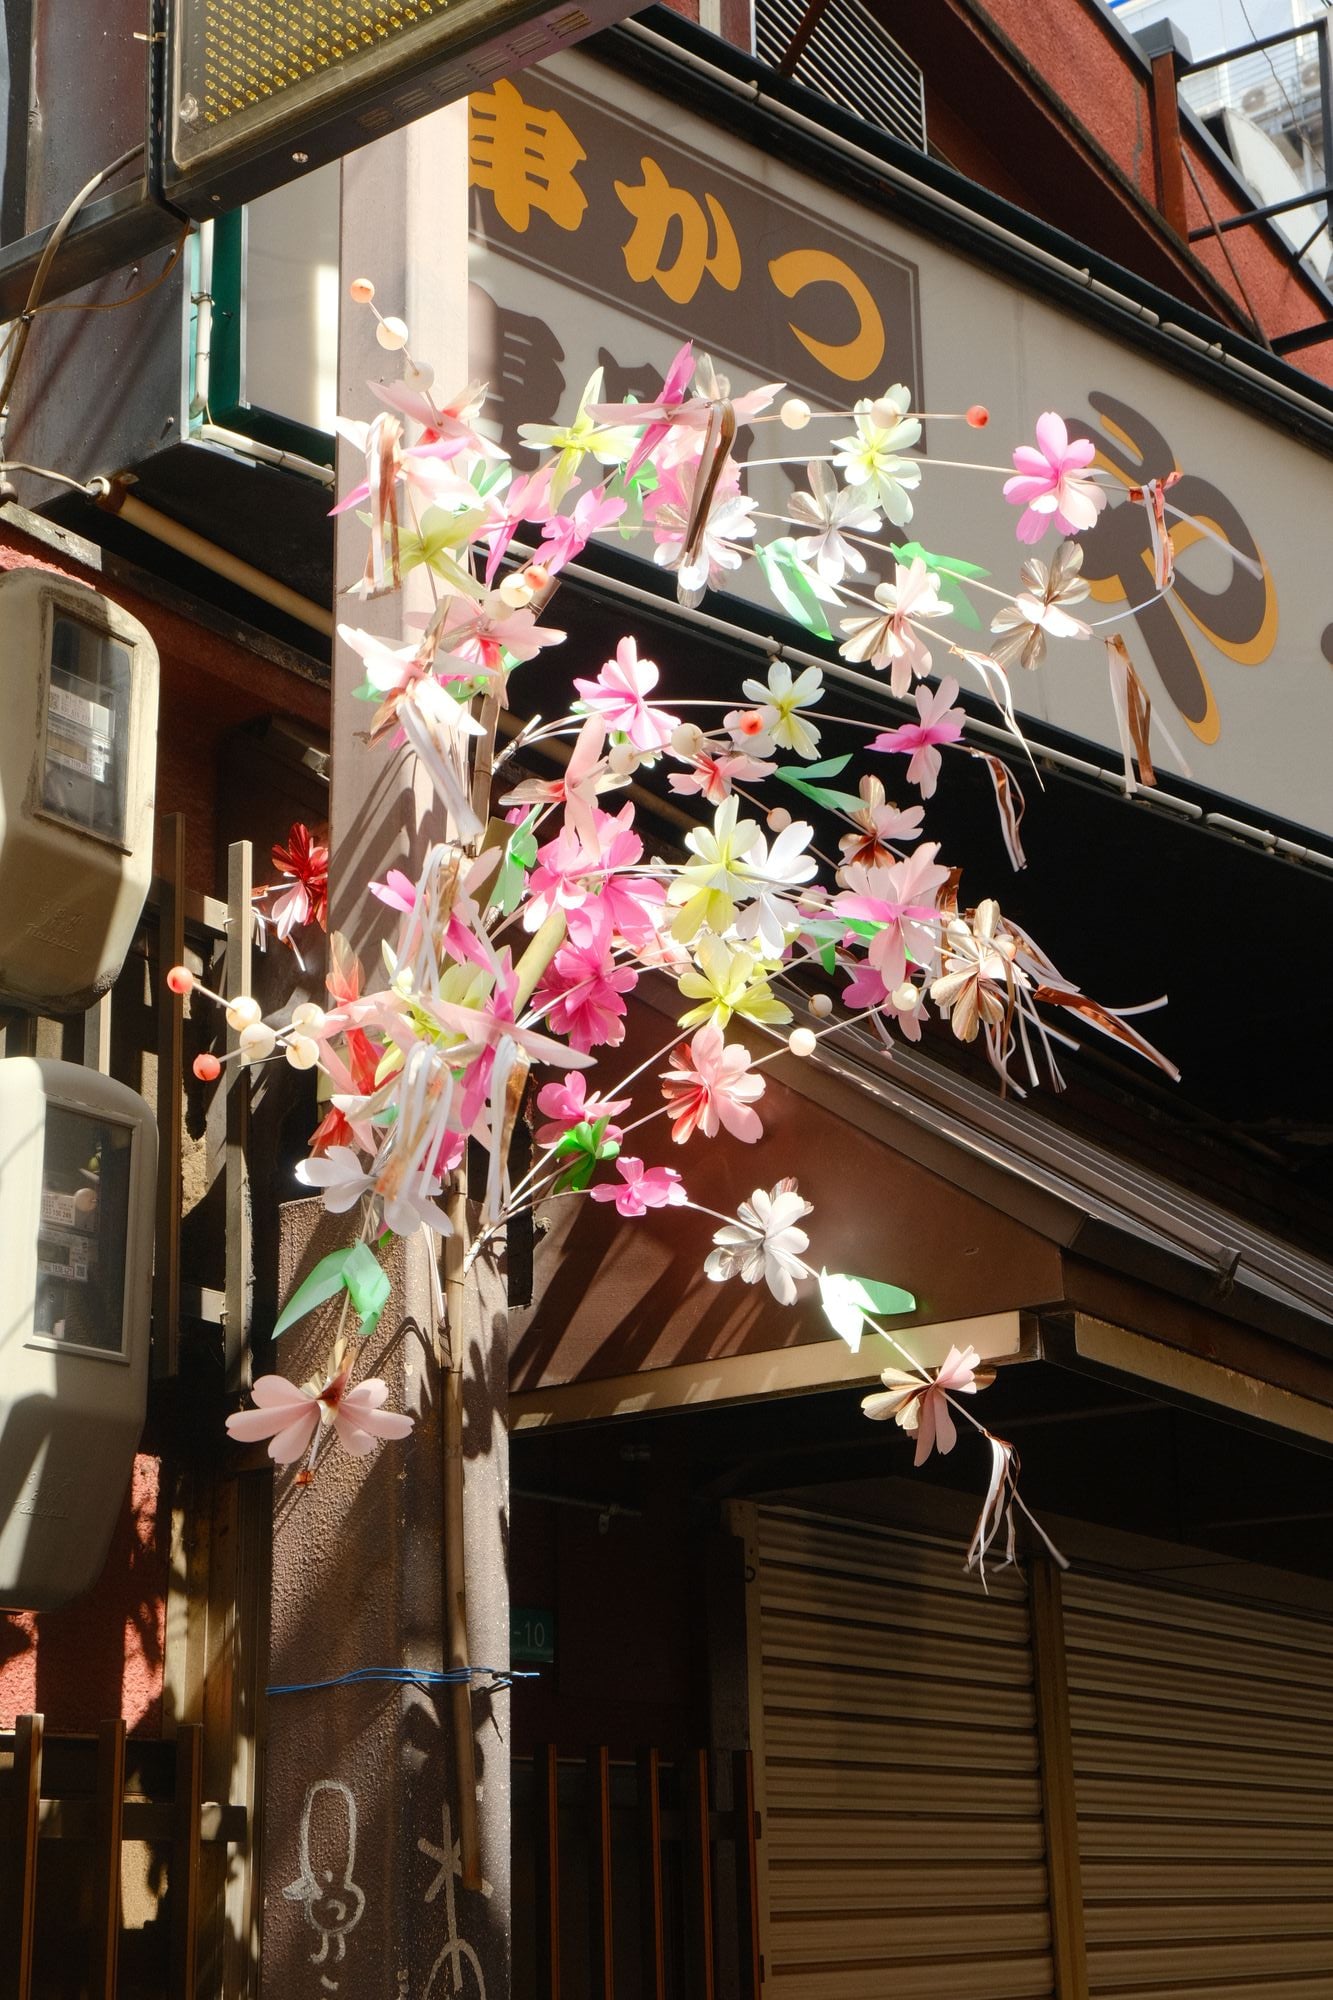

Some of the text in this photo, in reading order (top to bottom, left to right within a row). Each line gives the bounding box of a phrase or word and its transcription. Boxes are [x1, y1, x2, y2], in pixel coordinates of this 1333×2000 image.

[469, 79, 885, 380] 串かつ
[1062, 390, 1333, 746] や
